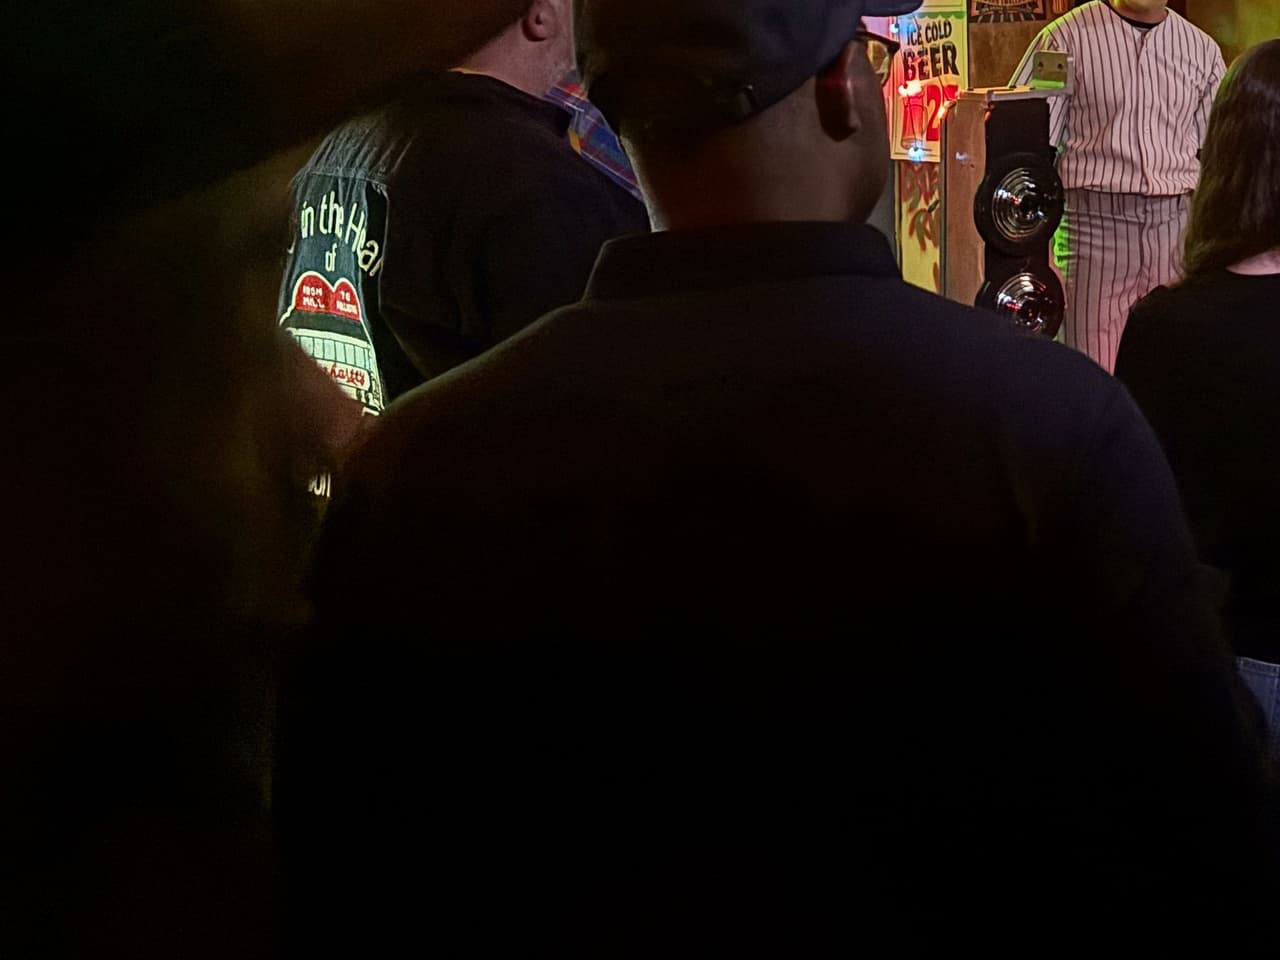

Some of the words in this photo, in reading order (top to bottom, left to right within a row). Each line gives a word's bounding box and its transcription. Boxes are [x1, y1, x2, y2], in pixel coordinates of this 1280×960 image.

[907, 25, 922, 45] ICE
[925, 20, 952, 44] COLD
[903, 42, 960, 81] BEER
[301, 201, 314, 239] in
[319, 191, 344, 238] the
[325, 242, 337, 272] of
